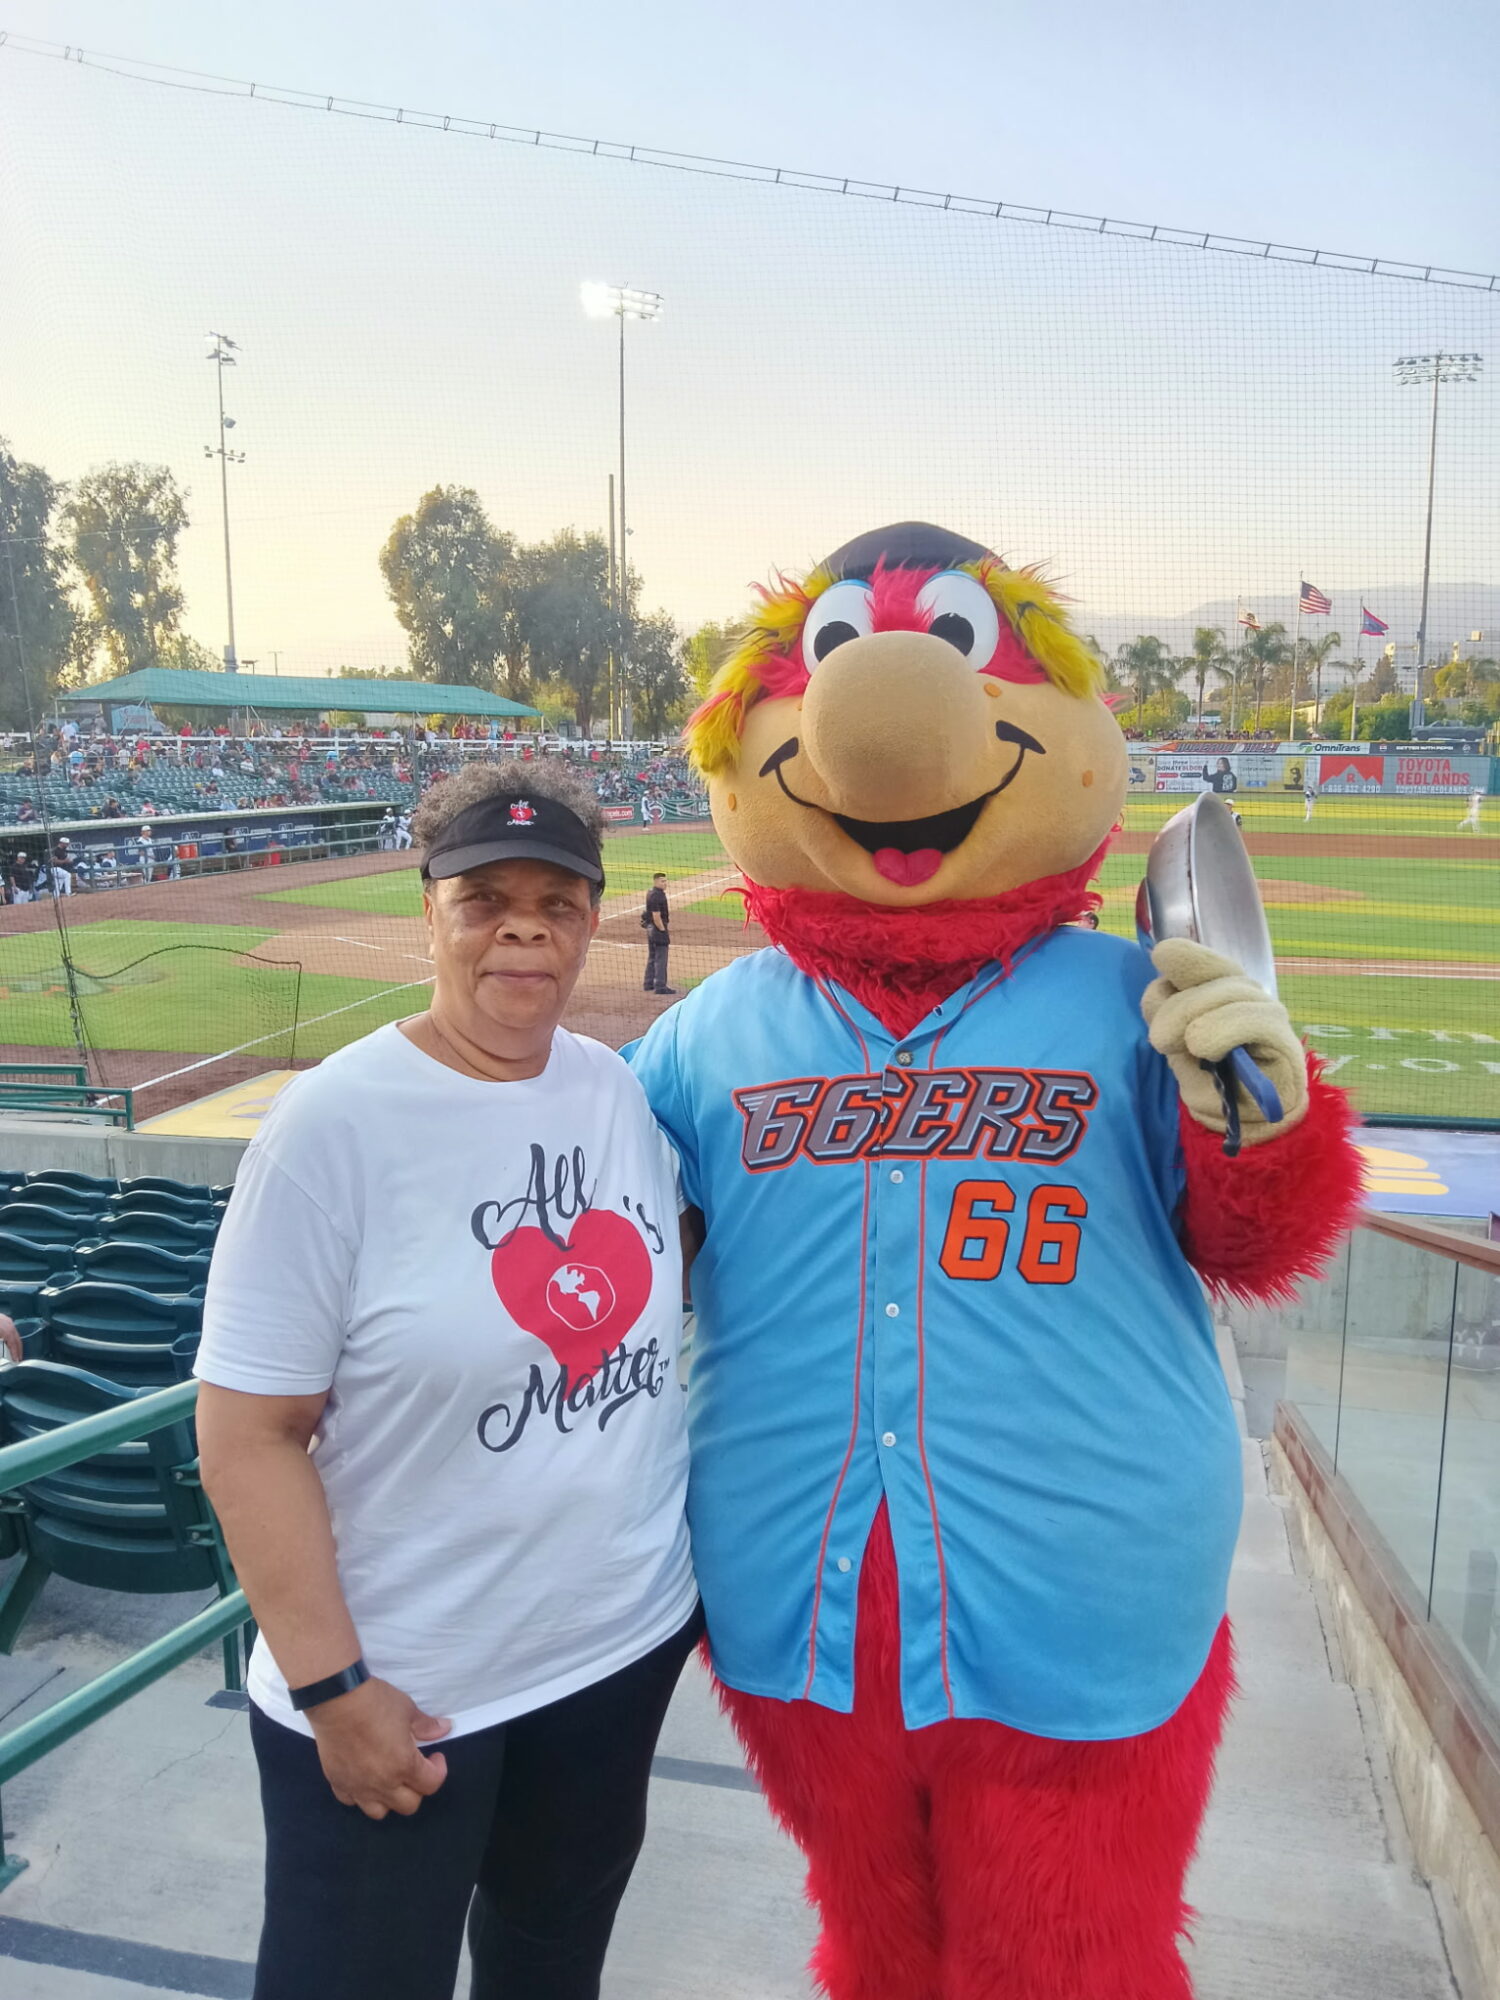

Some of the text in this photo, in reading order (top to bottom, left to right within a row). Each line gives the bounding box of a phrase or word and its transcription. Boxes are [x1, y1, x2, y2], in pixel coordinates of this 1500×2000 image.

[1314, 744, 1361, 752] OmniTrans
[1346, 773, 1355, 783] R
[1397, 759, 1451, 771] TOYOTA
[1396, 772, 1470, 786] REDLANDS
[733, 1064, 1099, 1174] 66ERS
[471, 1143, 598, 1252] All
[939, 1178, 1088, 1285] 66
[477, 1336, 663, 1453] Matter
